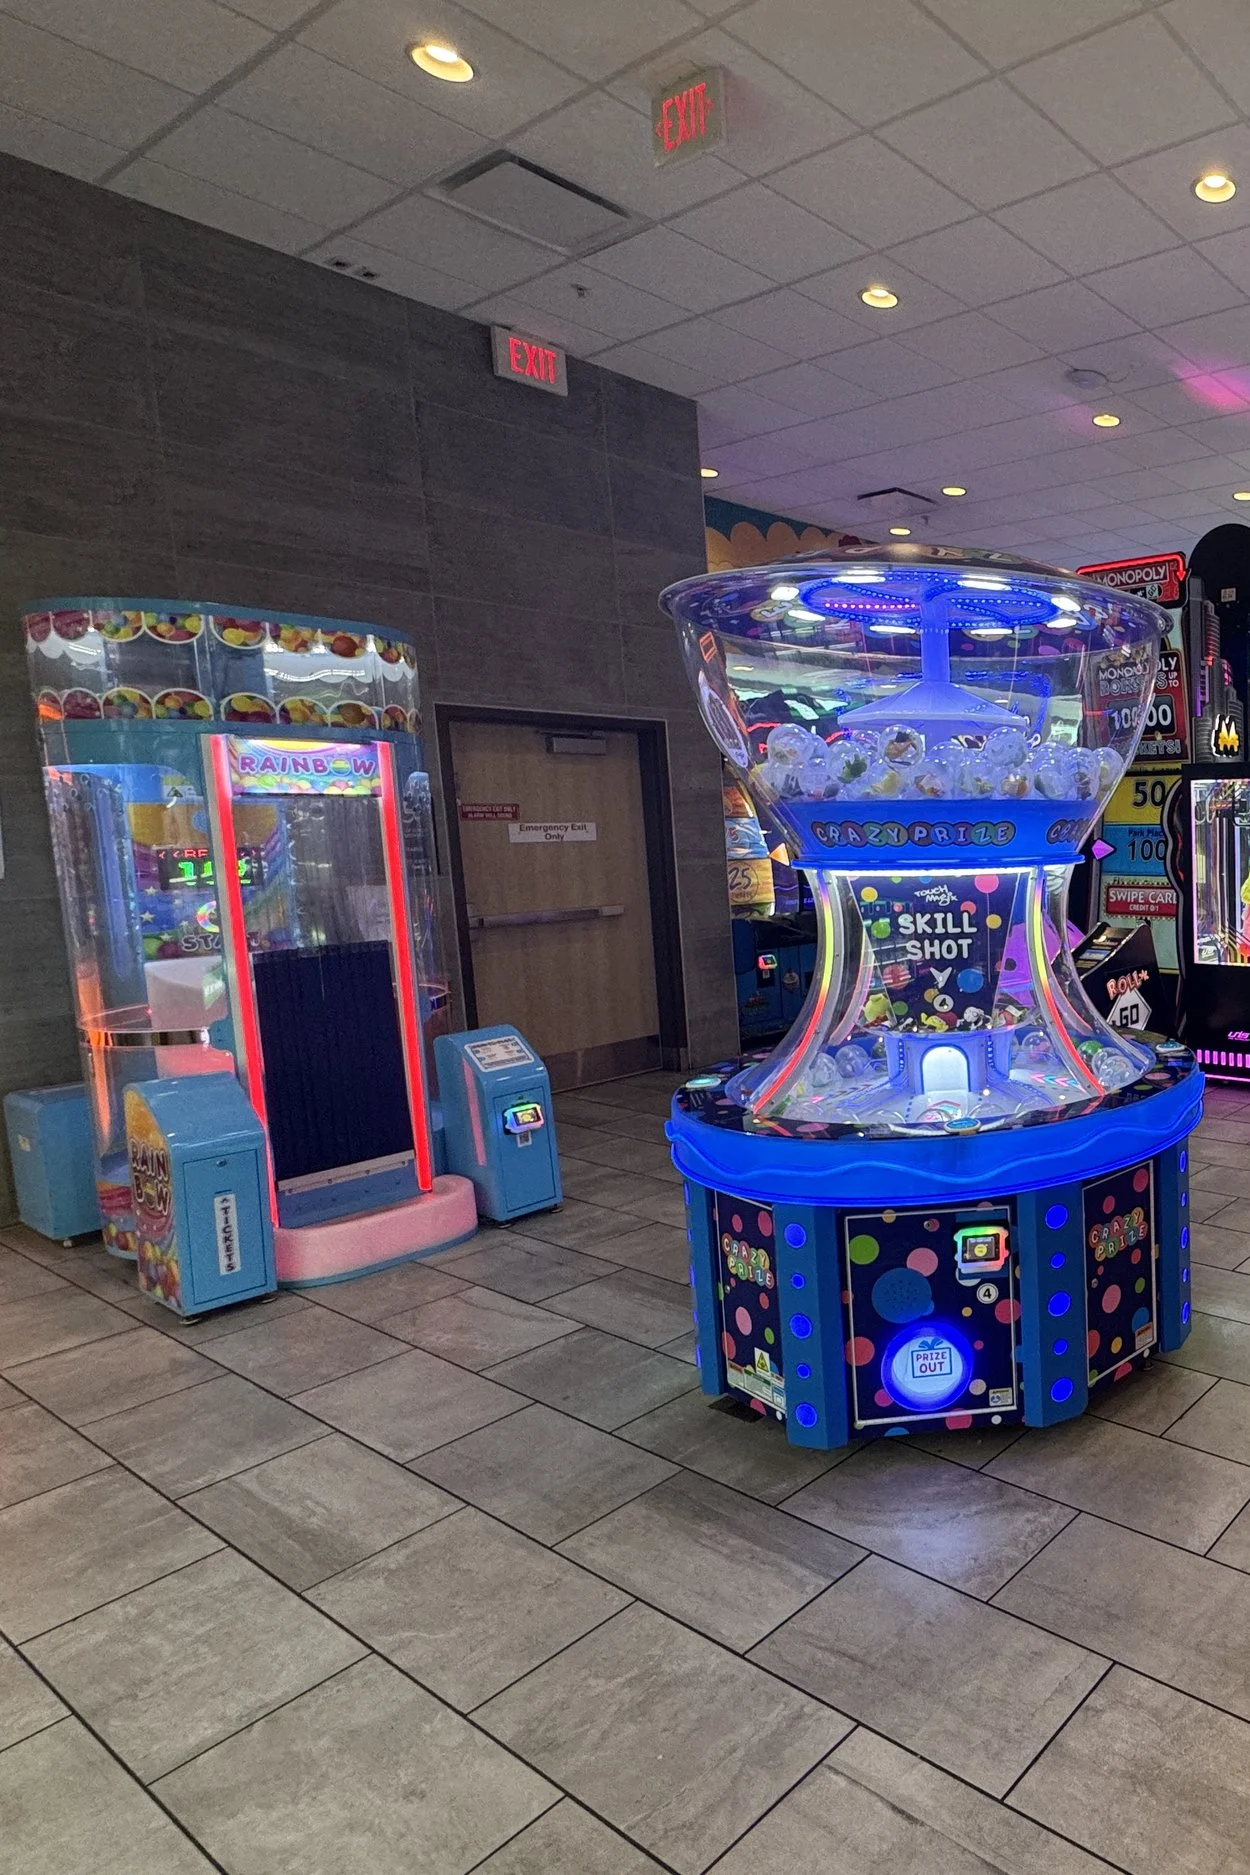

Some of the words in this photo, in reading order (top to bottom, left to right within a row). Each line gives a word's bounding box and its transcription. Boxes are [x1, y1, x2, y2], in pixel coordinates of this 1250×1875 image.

[661, 81, 708, 153] EXIT
[508, 336, 557, 385] EXIT
[1097, 565, 1166, 588] MONOPOLY
[1168, 671, 1178, 680] UP
[1168, 679, 1180, 688] TO
[238, 754, 378, 777] RAINBOW
[1132, 780, 1166, 808] 50
[519, 823, 569, 833] Emergency
[570, 823, 588, 832] Exit
[544, 832, 565, 842] Only
[815, 824, 903, 844] CRAZY
[912, 823, 1012, 844] PRIZE
[1127, 839, 1168, 861] 100
[729, 867, 752, 890] 25
[914, 884, 949, 898] TOUCH
[1109, 888, 1147, 903] SWIPE
[1129, 903, 1149, 912] CREDIT
[898, 911, 978, 934] SKILL
[906, 938, 973, 961] SHOT
[1106, 970, 1142, 1000] ROLL
[1119, 1003, 1140, 1027] GO
[130, 1138, 169, 1181] RAIN
[221, 1206, 237, 1272] TICKETS
[1091, 1211, 1142, 1244] CRAZY
[723, 1237, 768, 1268] CRAZY
[1097, 1224, 1146, 1258] PRIZE
[729, 1258, 772, 1287] PRIZE
[982, 1287, 992, 1299] 4
[915, 1351, 948, 1362] PRIZE
[919, 1361, 945, 1374] OUT
